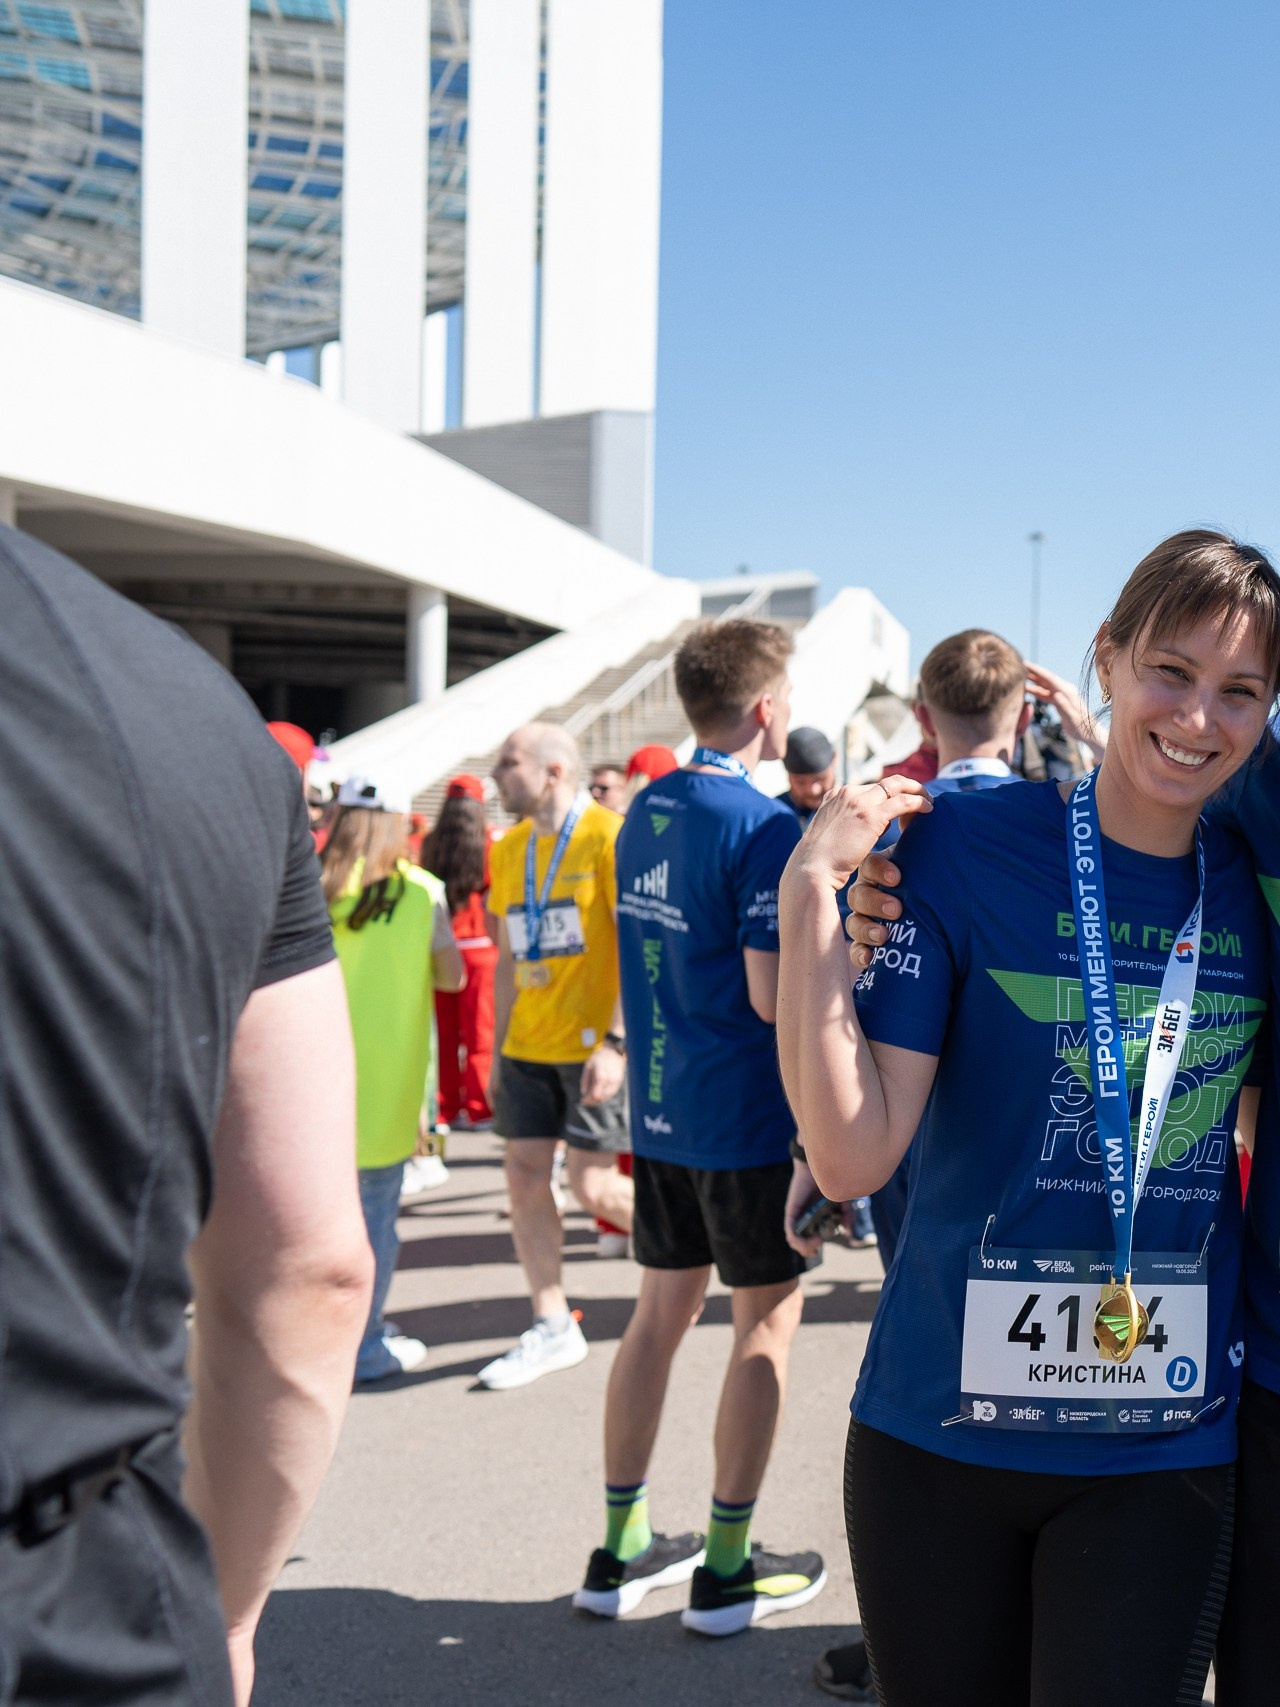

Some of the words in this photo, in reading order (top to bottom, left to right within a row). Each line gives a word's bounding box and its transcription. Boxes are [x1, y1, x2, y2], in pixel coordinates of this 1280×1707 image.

[1072, 808, 1095, 874] ЭТОТ
[1078, 879, 1108, 999] МЕНЯЮТ
[1143, 923, 1243, 958] ГЕОЙ!
[1058, 953, 1068, 961] 10
[1094, 1006, 1119, 1098] ГЕРОИ
[1143, 1097, 1159, 1147] ГЕРОЙ!
[1110, 1190, 1126, 1218] 10
[982, 1259, 995, 1269] 10
[997, 1260, 1017, 1270] КМ
[1008, 1294, 1168, 1352] 414
[1028, 1364, 1146, 1383] КРИСТИНА
[1172, 1361, 1192, 1387] D
[1174, 1411, 1192, 1419] ПСБ
